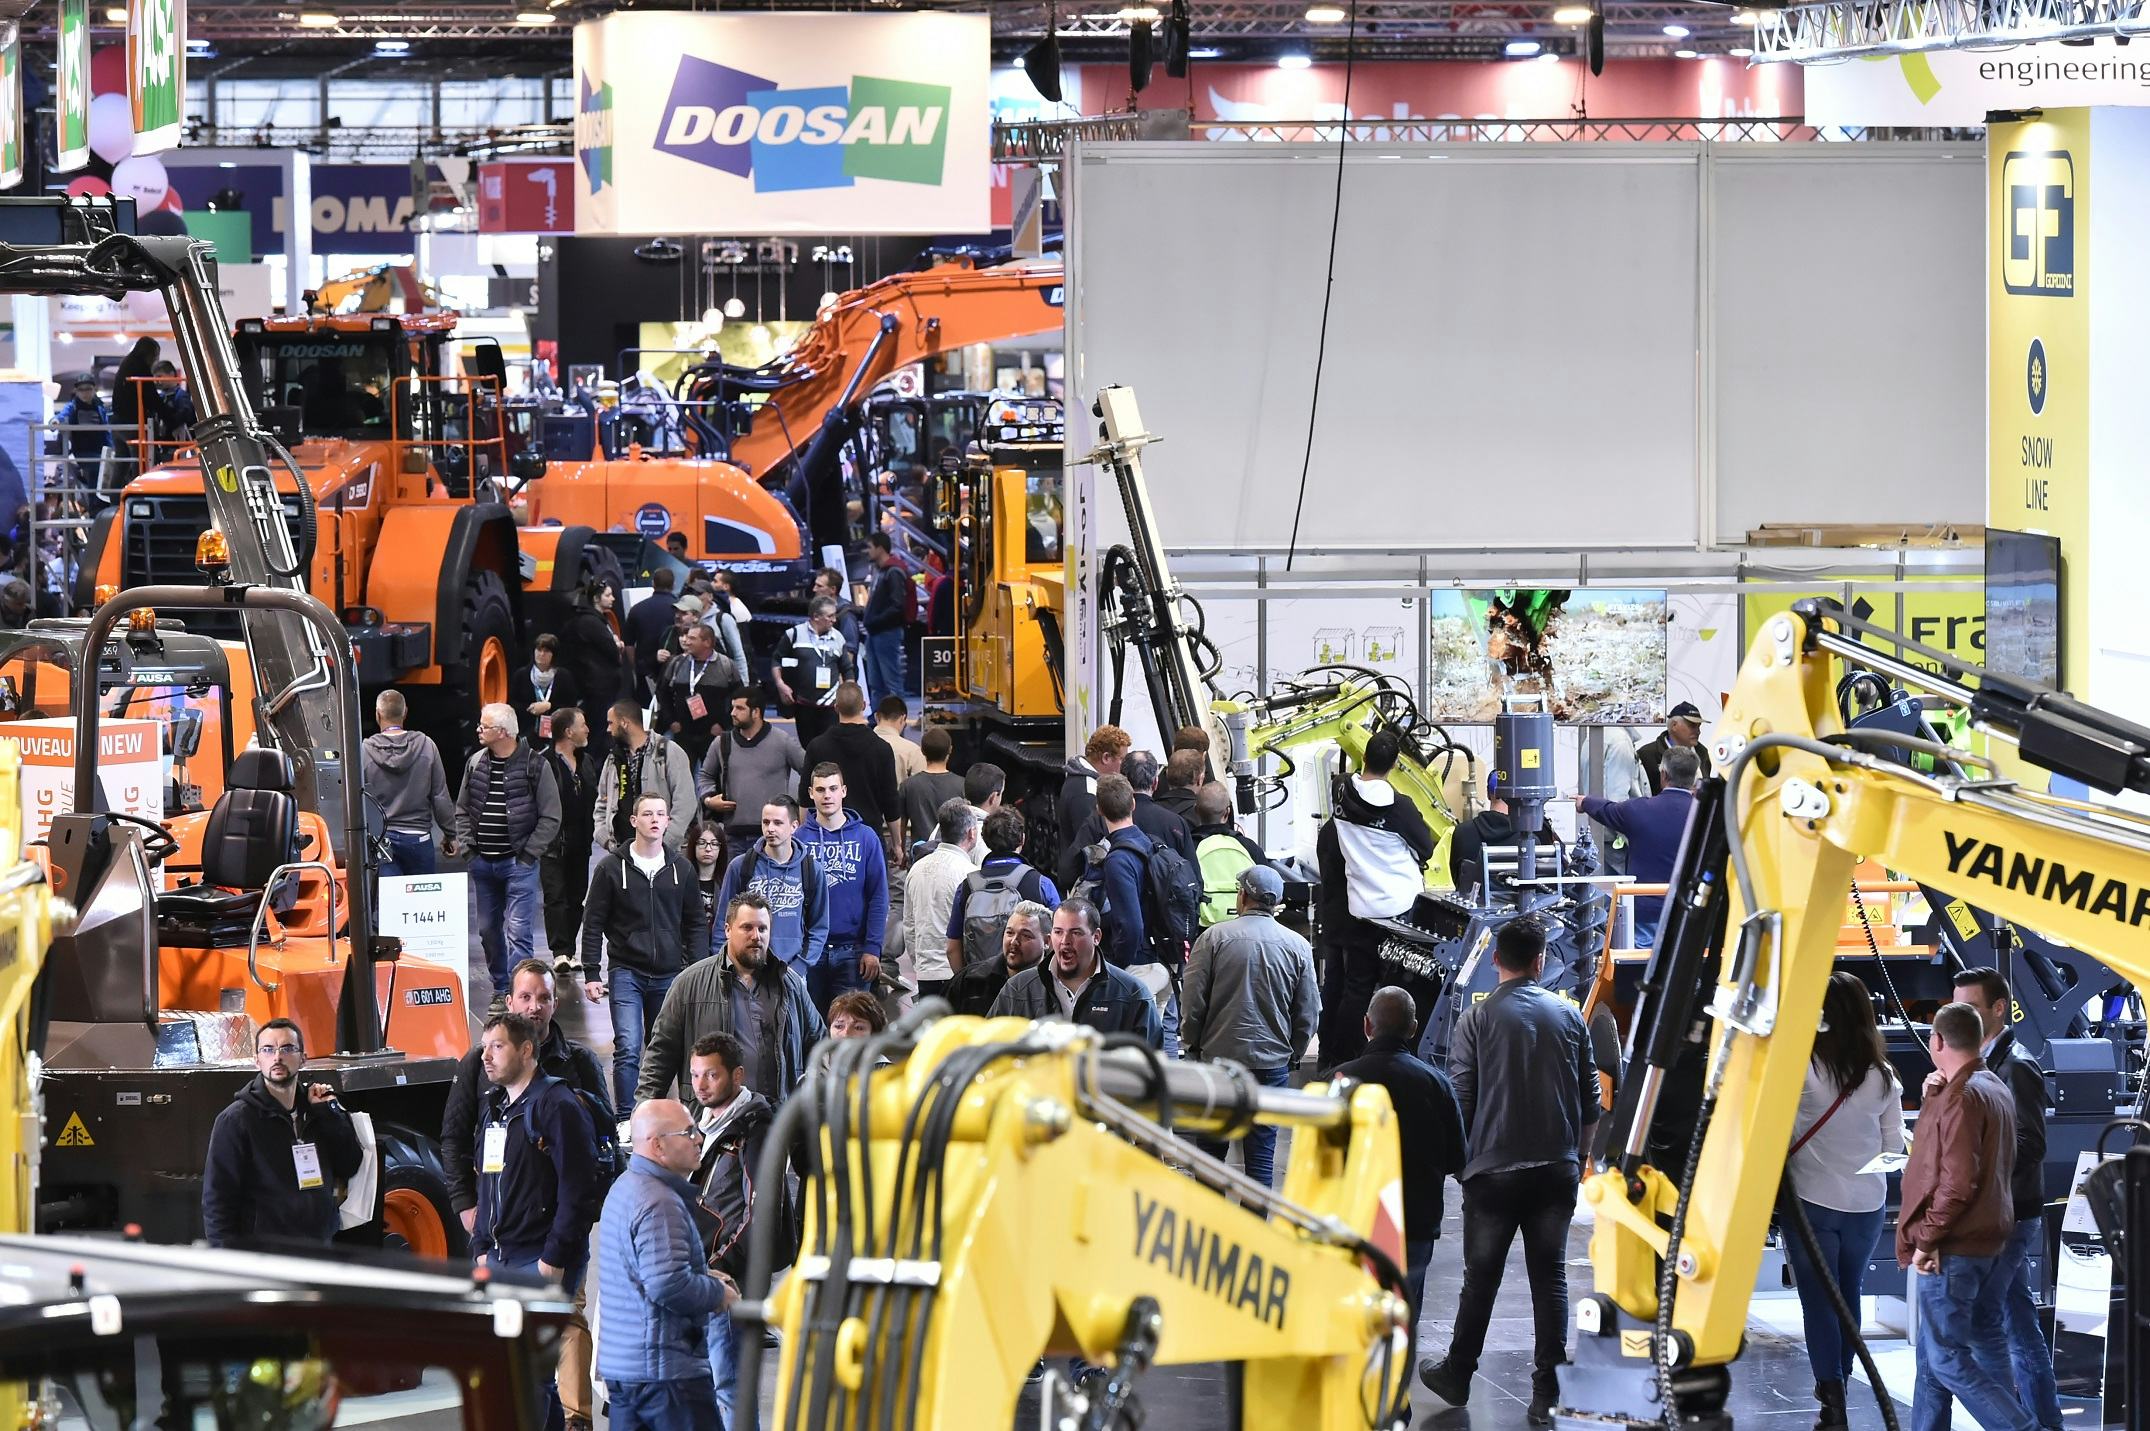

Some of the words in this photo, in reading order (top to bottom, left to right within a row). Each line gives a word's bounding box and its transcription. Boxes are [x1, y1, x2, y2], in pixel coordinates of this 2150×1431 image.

[664, 105, 943, 145] DOOSAN
[279, 344, 364, 357] DOOSAN
[2022, 435, 2053, 469] SNOW
[2026, 478, 2049, 511] LINE
[137, 674, 174, 682] AUSA
[101, 732, 143, 756] NEW
[413, 884, 441, 892] AUSA
[402, 913, 409, 924] T
[413, 912, 434, 924] 144
[437, 911, 446, 922] H
[413, 991, 420, 1004] D
[421, 990, 433, 1003] 601
[435, 989, 451, 1002] AHG
[1134, 1189, 1290, 1331] YANMAR
